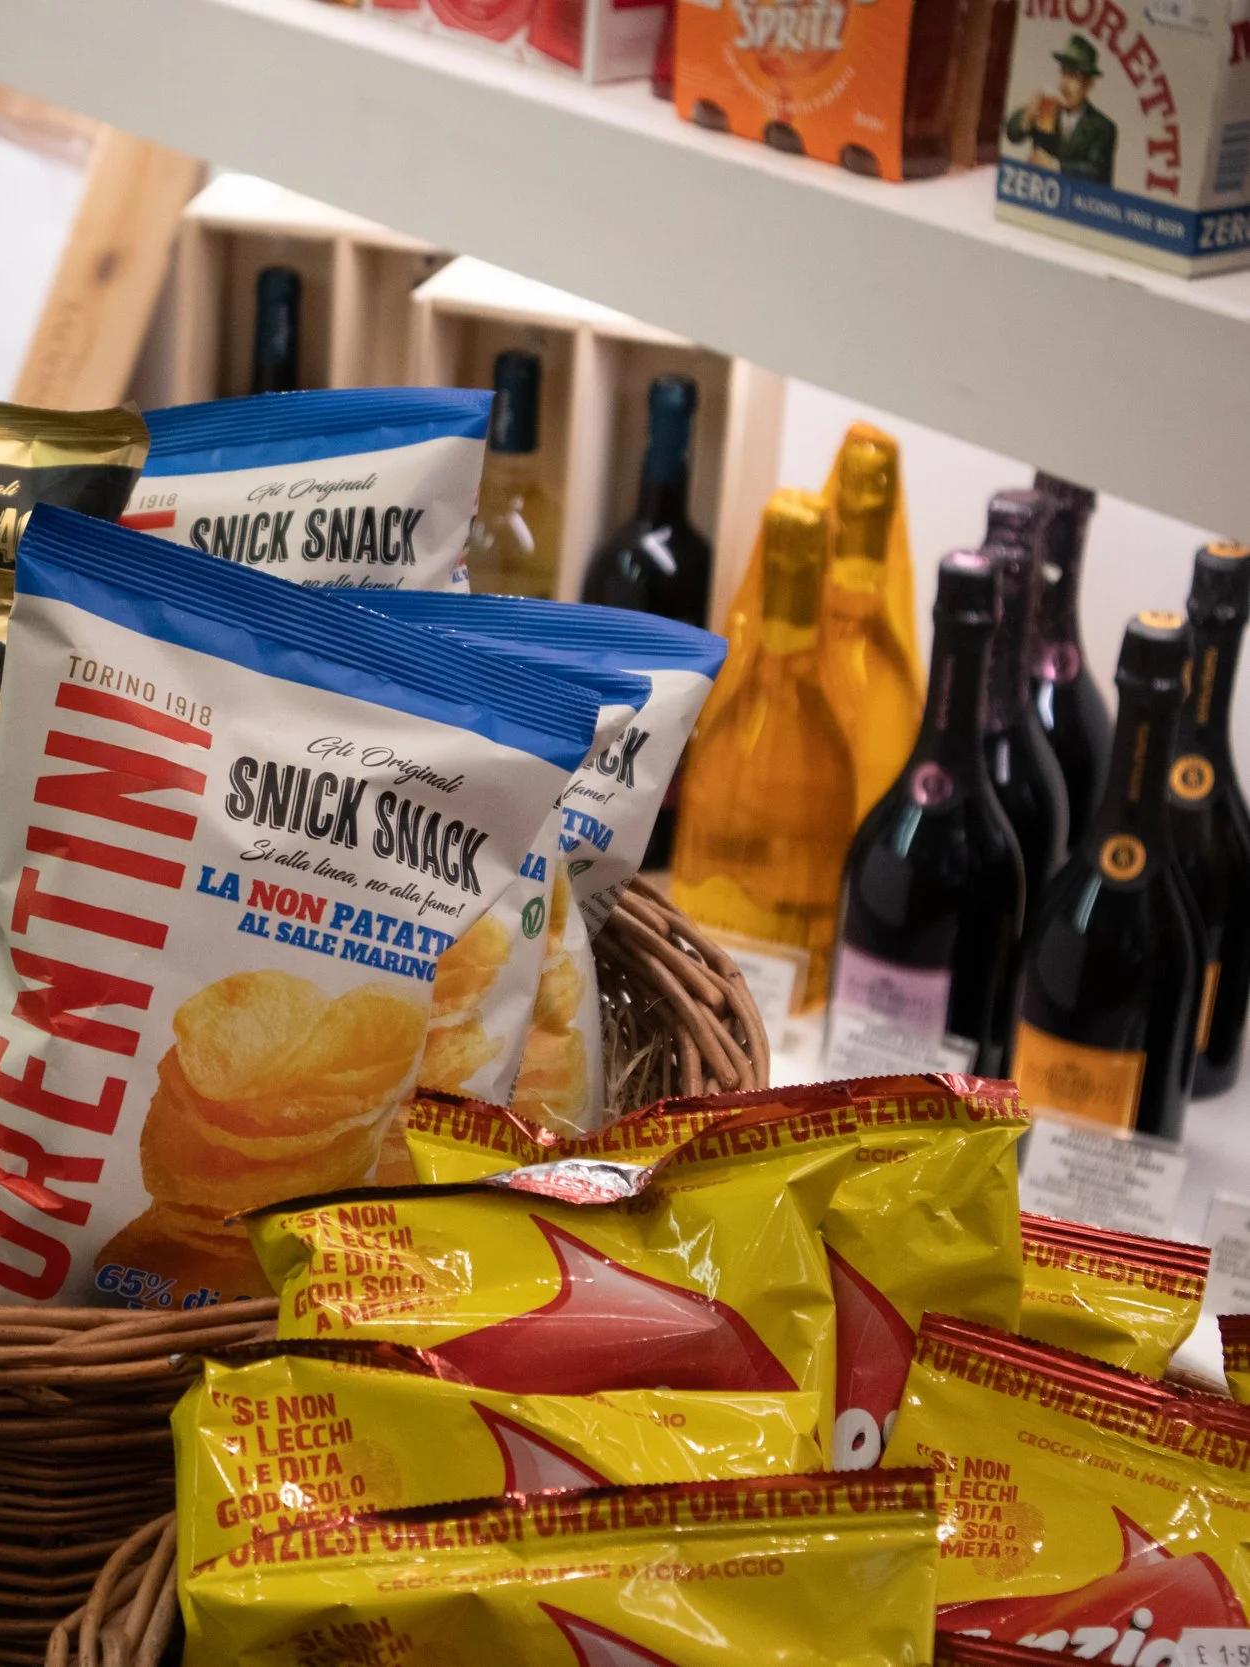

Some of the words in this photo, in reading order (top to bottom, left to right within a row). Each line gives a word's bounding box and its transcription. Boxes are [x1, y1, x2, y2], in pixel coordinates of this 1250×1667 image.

[1000, 163, 1061, 210] ZERO
[138, 492, 179, 511] 1918
[246, 481, 281, 504] Gli
[287, 472, 378, 503] Originali
[190, 510, 295, 564] SNICK
[301, 505, 425, 566] SNACK
[68, 654, 156, 704] TORINO
[164, 689, 214, 727] 1918
[307, 736, 353, 760] Gli
[361, 746, 465, 794] Originali
[562, 779, 615, 806] fame!
[225, 756, 368, 850] SNICK
[372, 789, 490, 897] SNACK
[561, 807, 614, 852] TINA
[196, 864, 241, 903] LA
[246, 878, 328, 925] NON
[239, 838, 271, 861] Si
[273, 849, 312, 872] alla
[313, 857, 359, 889] linea,
[364, 876, 390, 892] no
[390, 883, 422, 904] alla
[417, 890, 466, 919] fame!
[238, 911, 271, 939] AL
[274, 920, 339, 958] SALE
[339, 940, 438, 983] MARINO
[337, 1203, 397, 1231] NON
[322, 1225, 415, 1251] LECCHI
[308, 1252, 338, 1276] LE
[343, 1251, 404, 1277] DITA
[96, 1263, 178, 1307] 65%
[293, 1279, 353, 1321] GODI
[361, 1274, 426, 1303] SOLO
[316, 1311, 332, 1335] A
[276, 1392, 337, 1425] NON
[256, 1418, 354, 1456] LECCHI
[238, 1462, 273, 1487] LE
[277, 1452, 343, 1484] DITA
[964, 1456, 1010, 1482] NON
[1017, 1429, 1122, 1476] CROCCANTINI
[1124, 1466, 1139, 1480] DI
[1140, 1466, 1182, 1494] MAIS
[216, 1491, 291, 1530] GOD
[302, 1474, 366, 1505] SOLO
[944, 1475, 1018, 1502] LECCHI
[954, 1500, 1003, 1523] DITA
[961, 1522, 1016, 1541] SOLO
[377, 1567, 529, 1593] CROCCANTINI
[558, 1563, 611, 1580] MAIS
[1196, 1645, 1206, 1666] £
